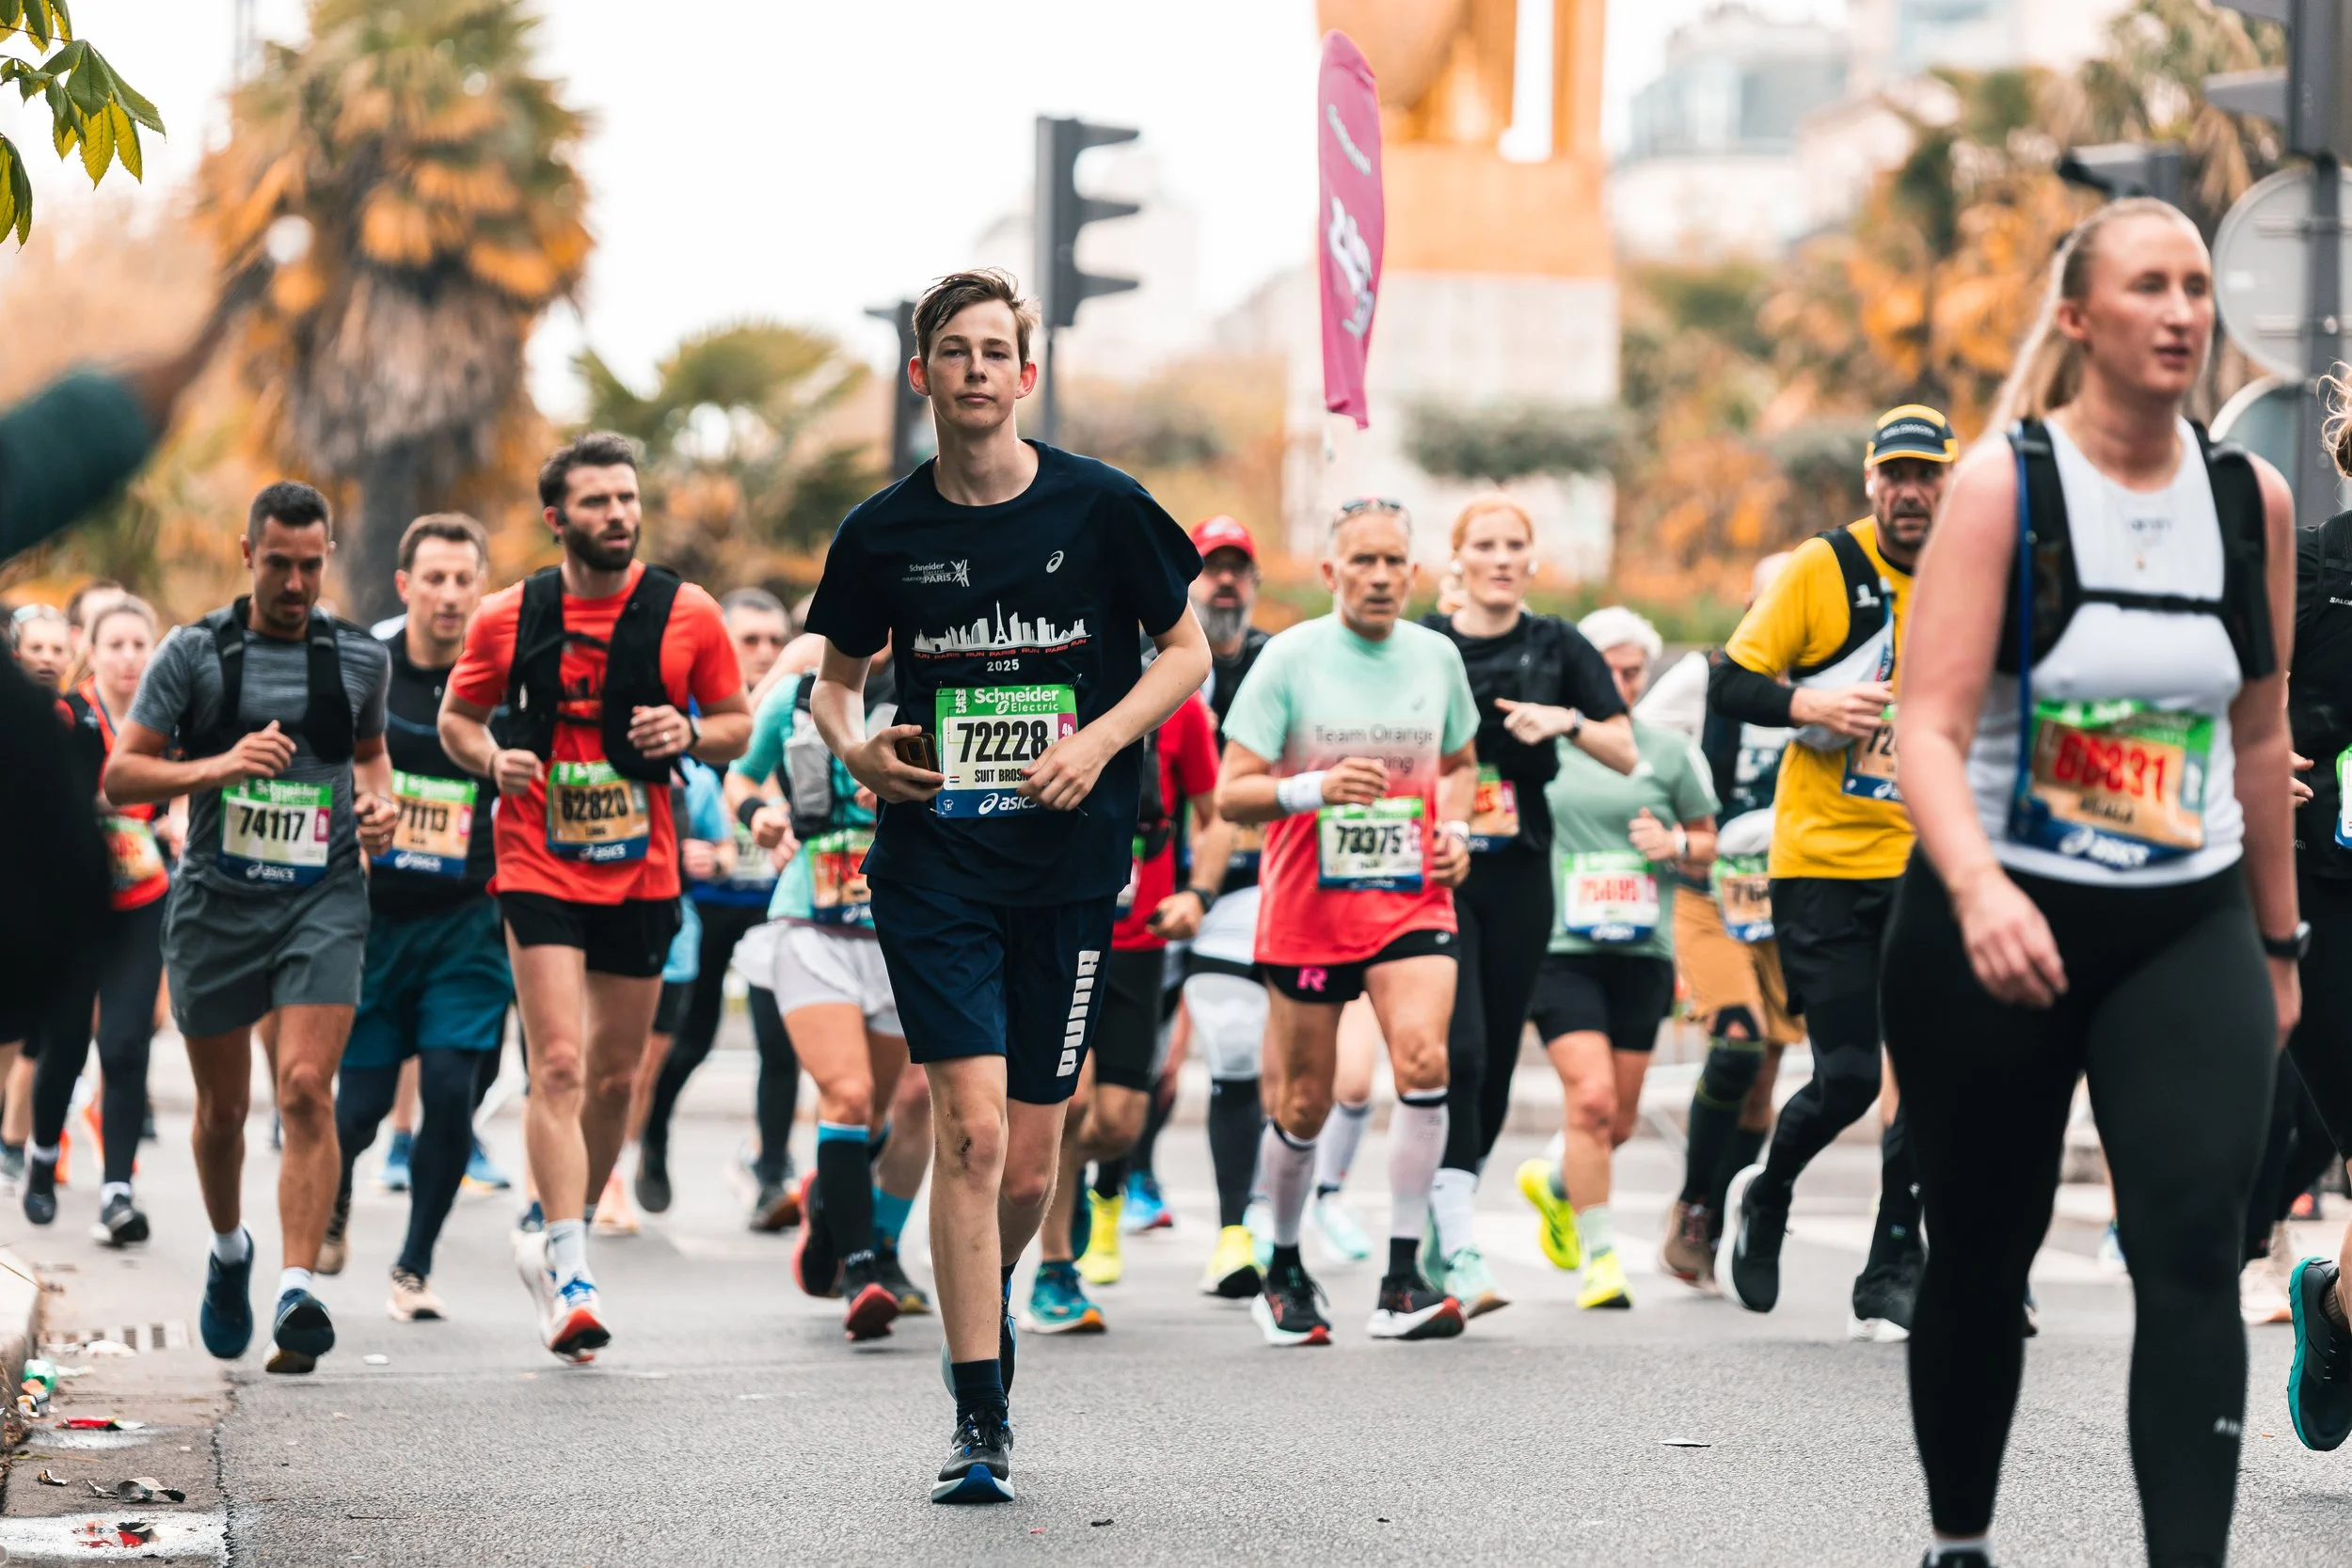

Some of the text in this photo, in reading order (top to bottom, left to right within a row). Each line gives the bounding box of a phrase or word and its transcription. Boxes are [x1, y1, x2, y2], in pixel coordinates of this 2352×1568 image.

[909, 562, 946, 572] Schneider
[924, 574, 952, 583] PARIS
[989, 649, 1017, 657] PARIS
[1045, 644, 1069, 654] PARIS
[1071, 638, 1087, 647] RUN
[986, 658, 1020, 672] 2025
[974, 688, 1059, 704] Schneider
[1010, 703, 1059, 712] Electric
[957, 720, 1049, 763] 72228
[1316, 723, 1434, 749] Team Orange
[974, 768, 1028, 783] SUIT BROS
[562, 787, 628, 821] 62820
[239, 805, 306, 844] 74117
[1336, 824, 1402, 855] 73375
[261, 864, 295, 881] asics
[1056, 950, 1101, 1077] PUMA
